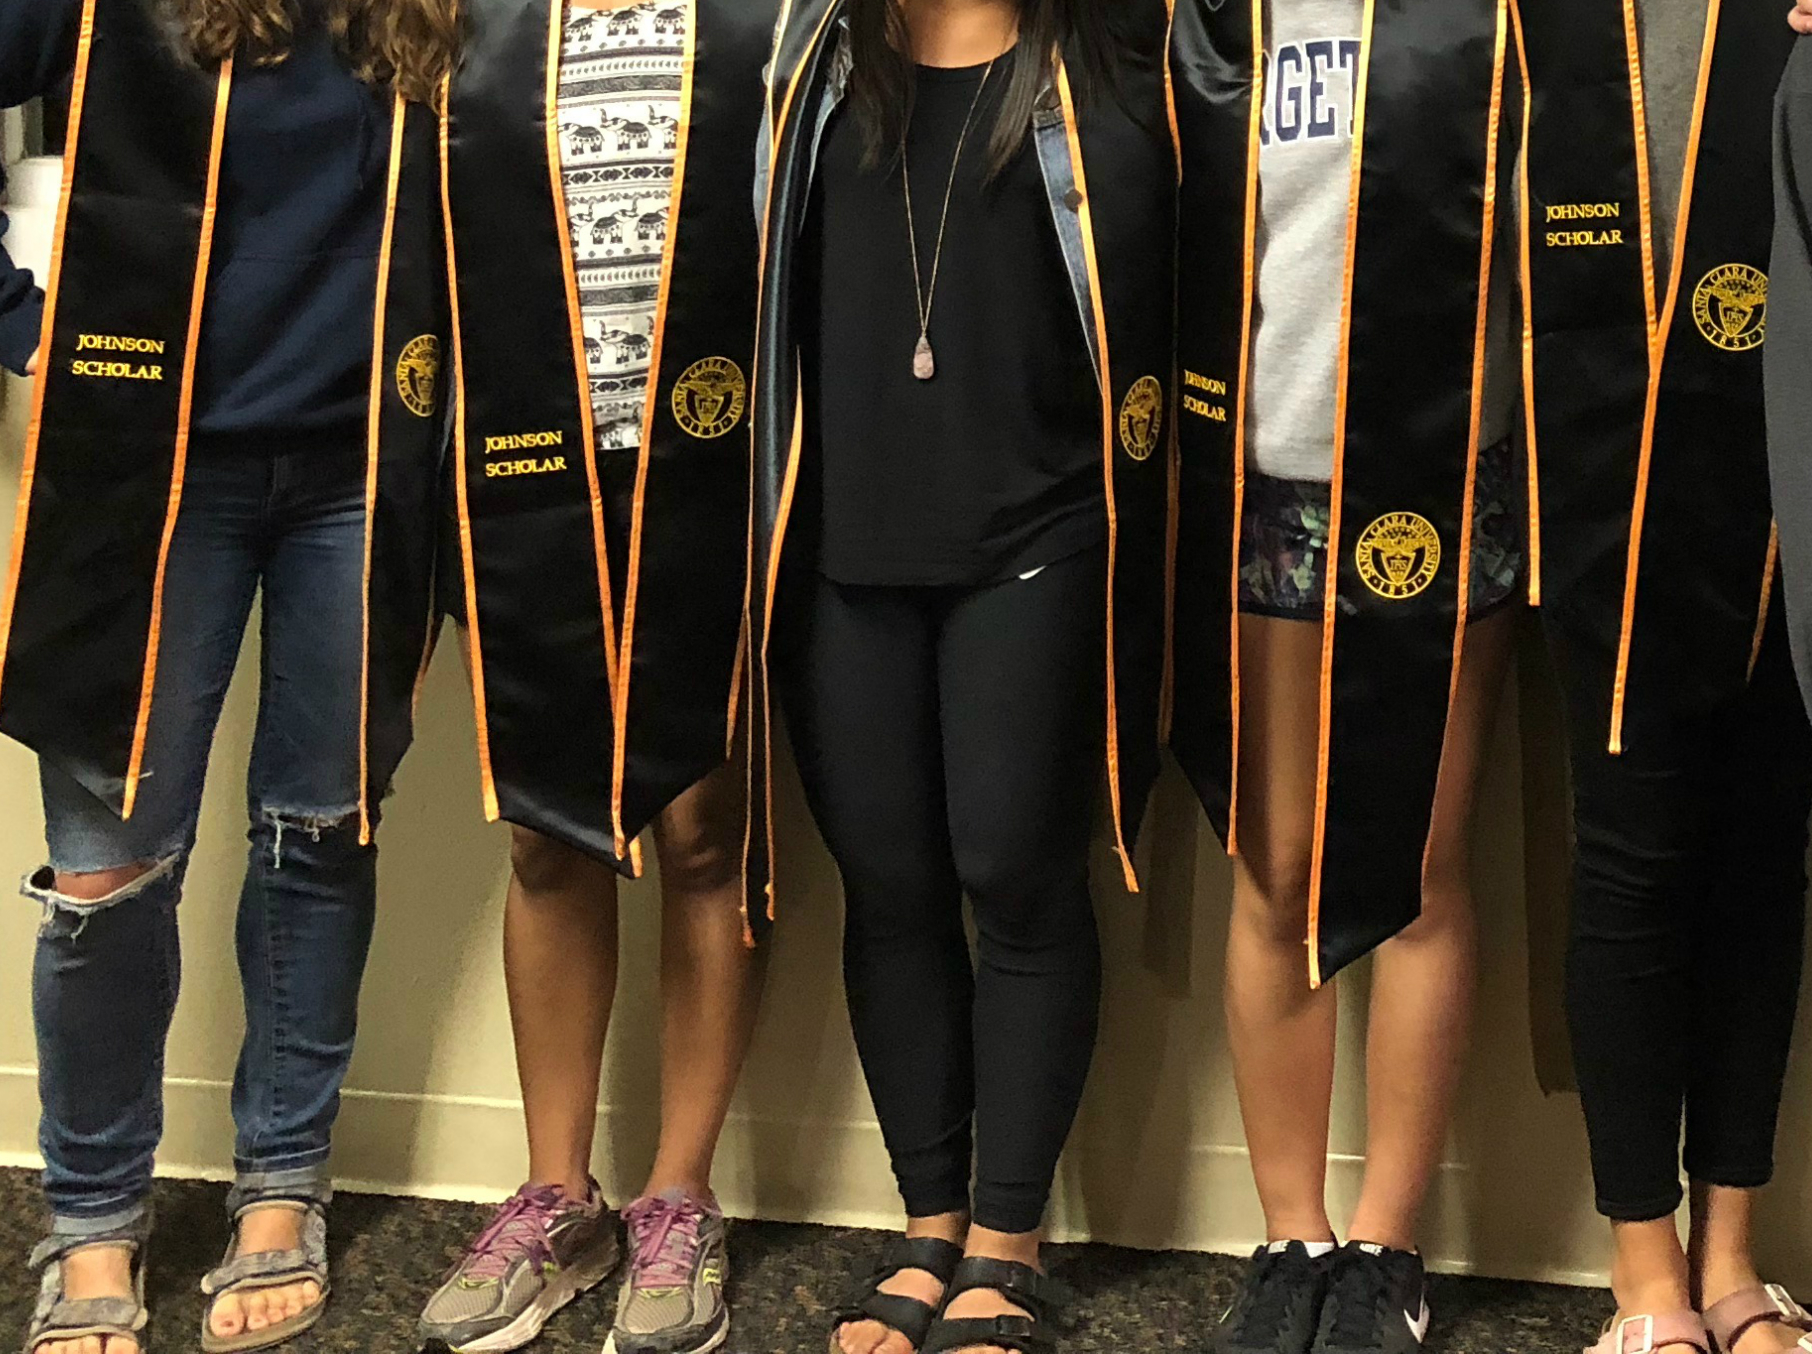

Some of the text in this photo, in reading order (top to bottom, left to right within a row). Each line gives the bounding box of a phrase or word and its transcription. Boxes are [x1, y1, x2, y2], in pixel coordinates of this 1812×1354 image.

[1545, 202, 1620, 223] JOHNSON
[1545, 229, 1624, 247] SCHOLAR
[75, 333, 166, 355] JOHNSON
[71, 359, 163, 380] SCHOLAR
[1183, 368, 1226, 396] JOHNSON
[1183, 394, 1227, 422] SCHOLAR
[484, 430, 563, 455] JOHNSON
[485, 456, 568, 478] SCHOLAR
